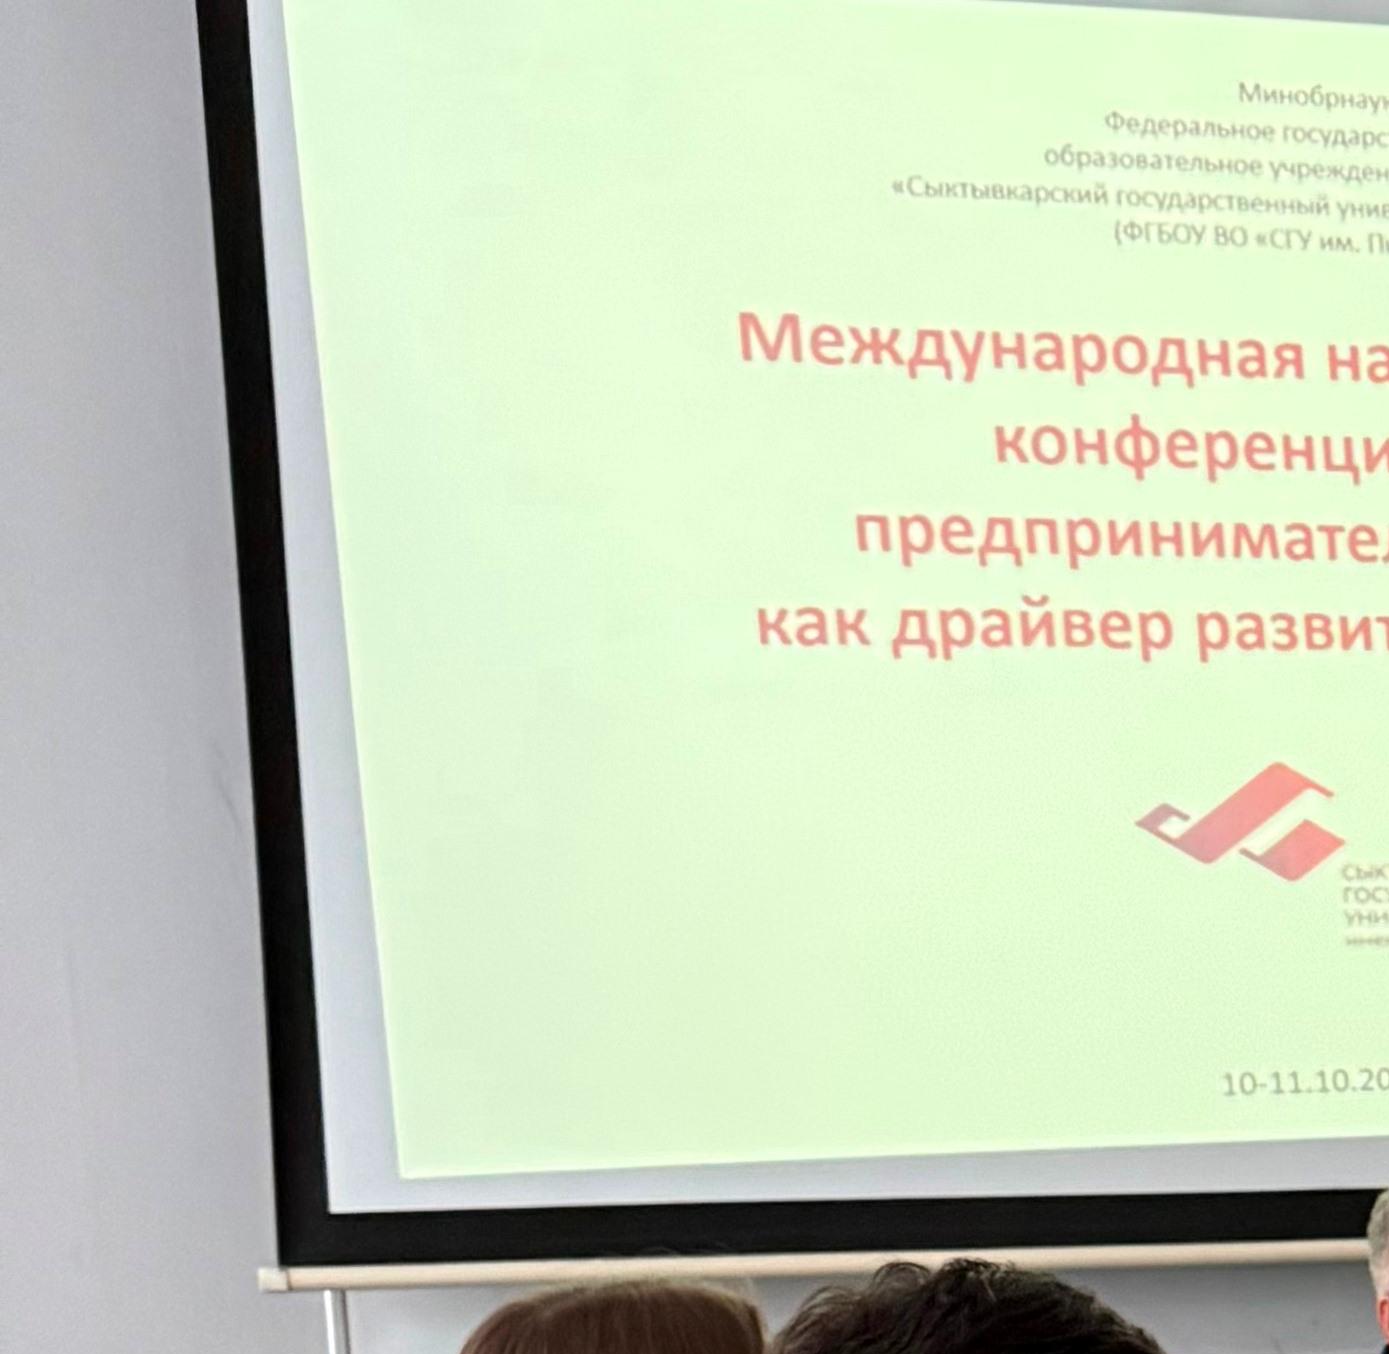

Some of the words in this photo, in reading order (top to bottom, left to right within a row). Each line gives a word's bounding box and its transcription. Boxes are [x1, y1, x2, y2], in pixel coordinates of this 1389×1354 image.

[1104, 110, 1275, 143] Федеральное
[1044, 143, 1263, 178] образовательное
[892, 175, 1109, 206] «Сыктывкарский
[1116, 189, 1330, 216] государственный
[1114, 220, 1206, 246] (ФГБОУ
[1214, 225, 1248, 248] ВО
[1255, 228, 1312, 251] «СГУ
[1320, 236, 1360, 253] им.
[739, 312, 1305, 389] Международная
[757, 606, 871, 647] как
[891, 595, 1173, 663] драйвер
